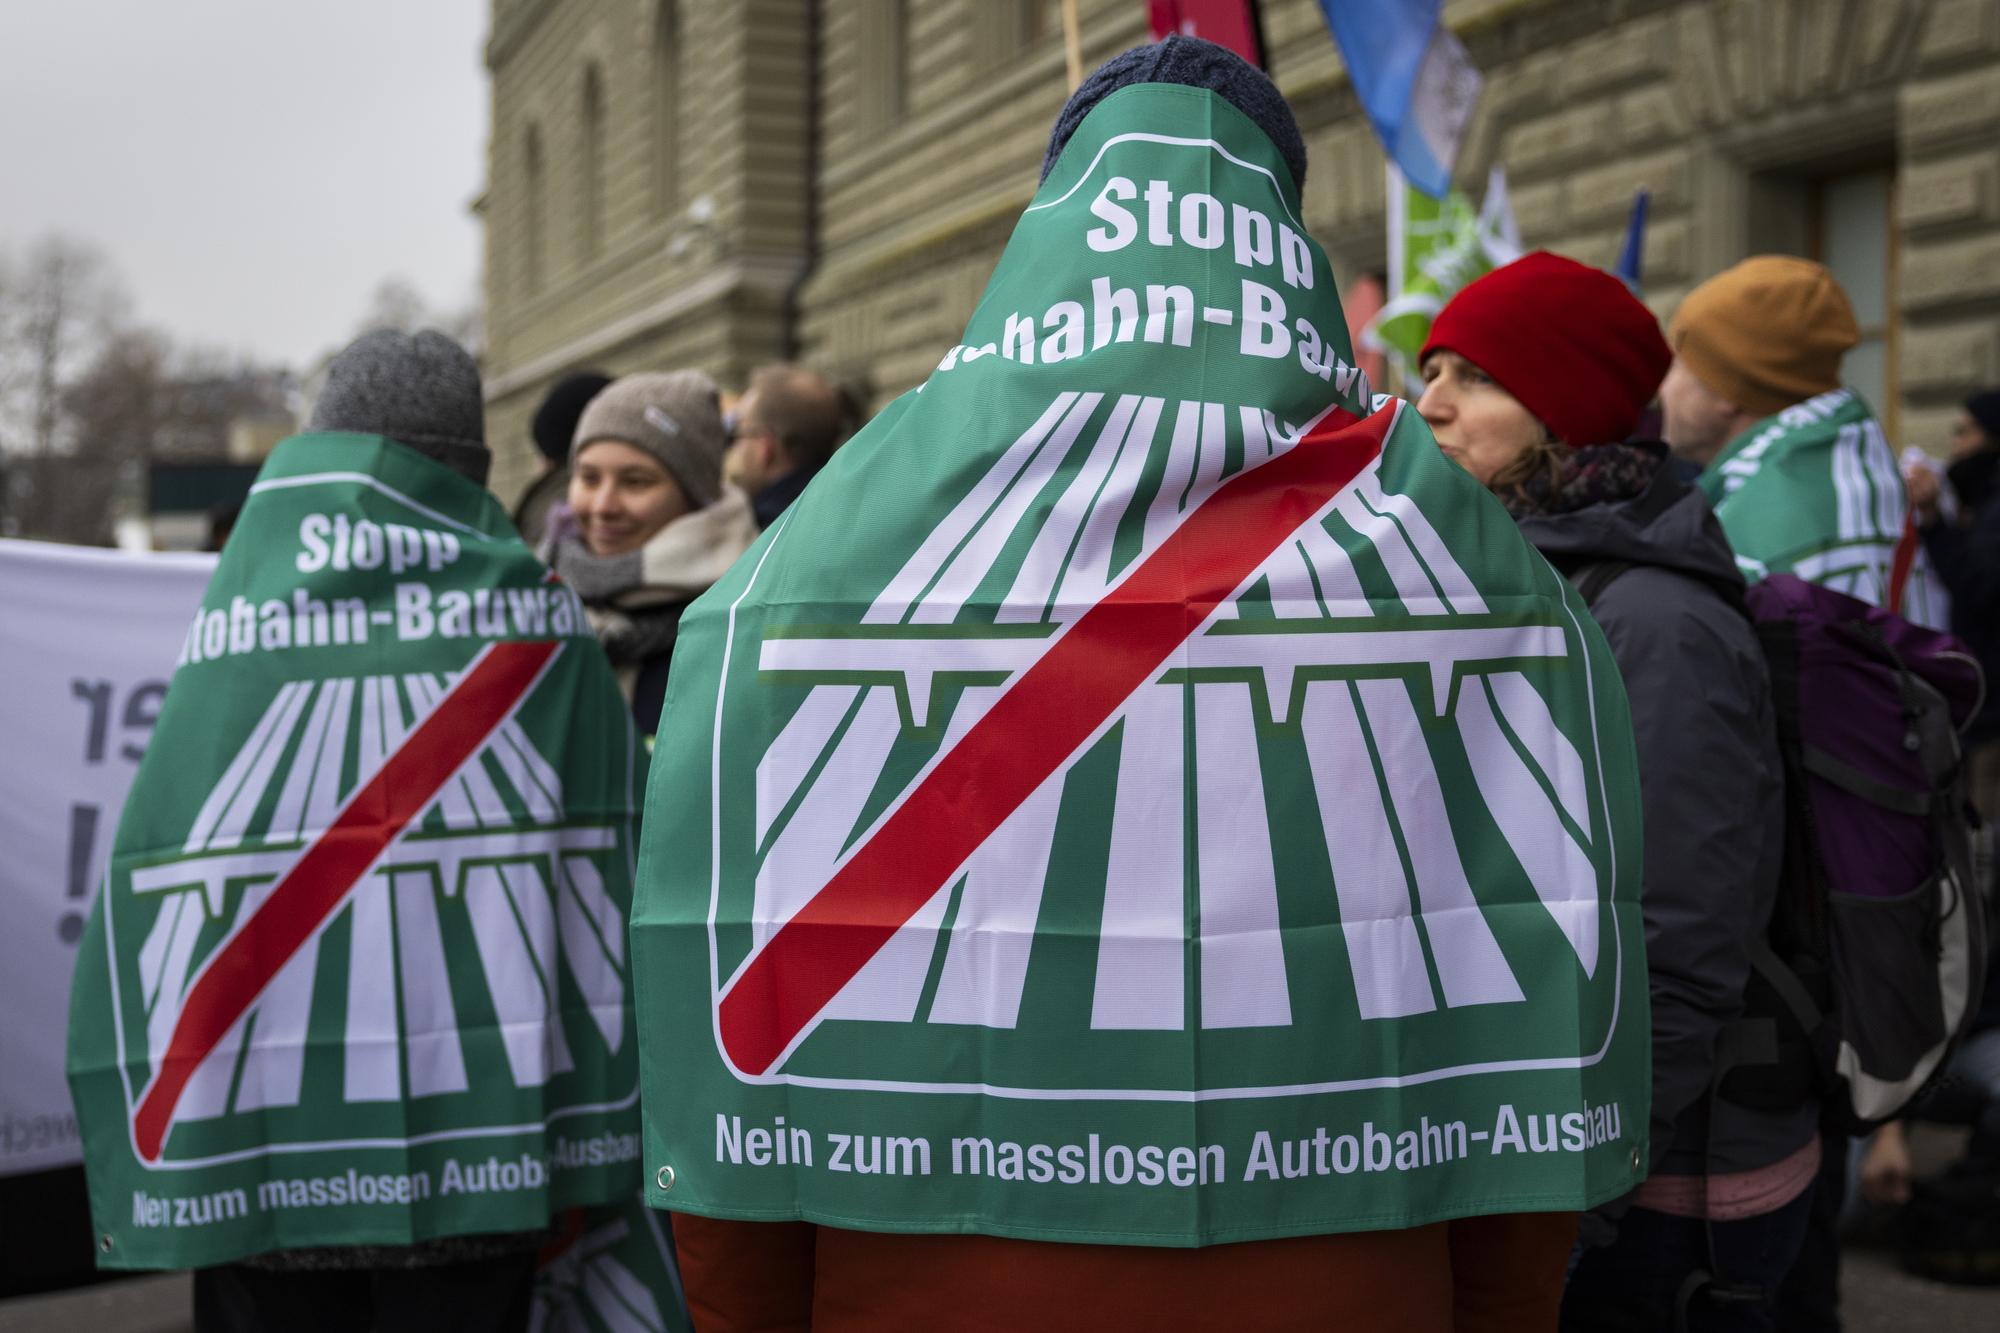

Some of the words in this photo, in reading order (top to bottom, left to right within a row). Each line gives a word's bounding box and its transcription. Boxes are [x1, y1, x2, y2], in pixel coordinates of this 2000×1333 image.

[1087, 177, 1314, 290] Stopp
[296, 513, 461, 574] Stopp
[715, 1113, 813, 1167] Nein
[827, 1133, 931, 1176] zum
[951, 1133, 1225, 1187] masslosen
[1243, 1099, 1621, 1182] Autobahn-Ausbau
[173, 1188, 247, 1227] zum
[258, 1170, 430, 1206] masslosen
